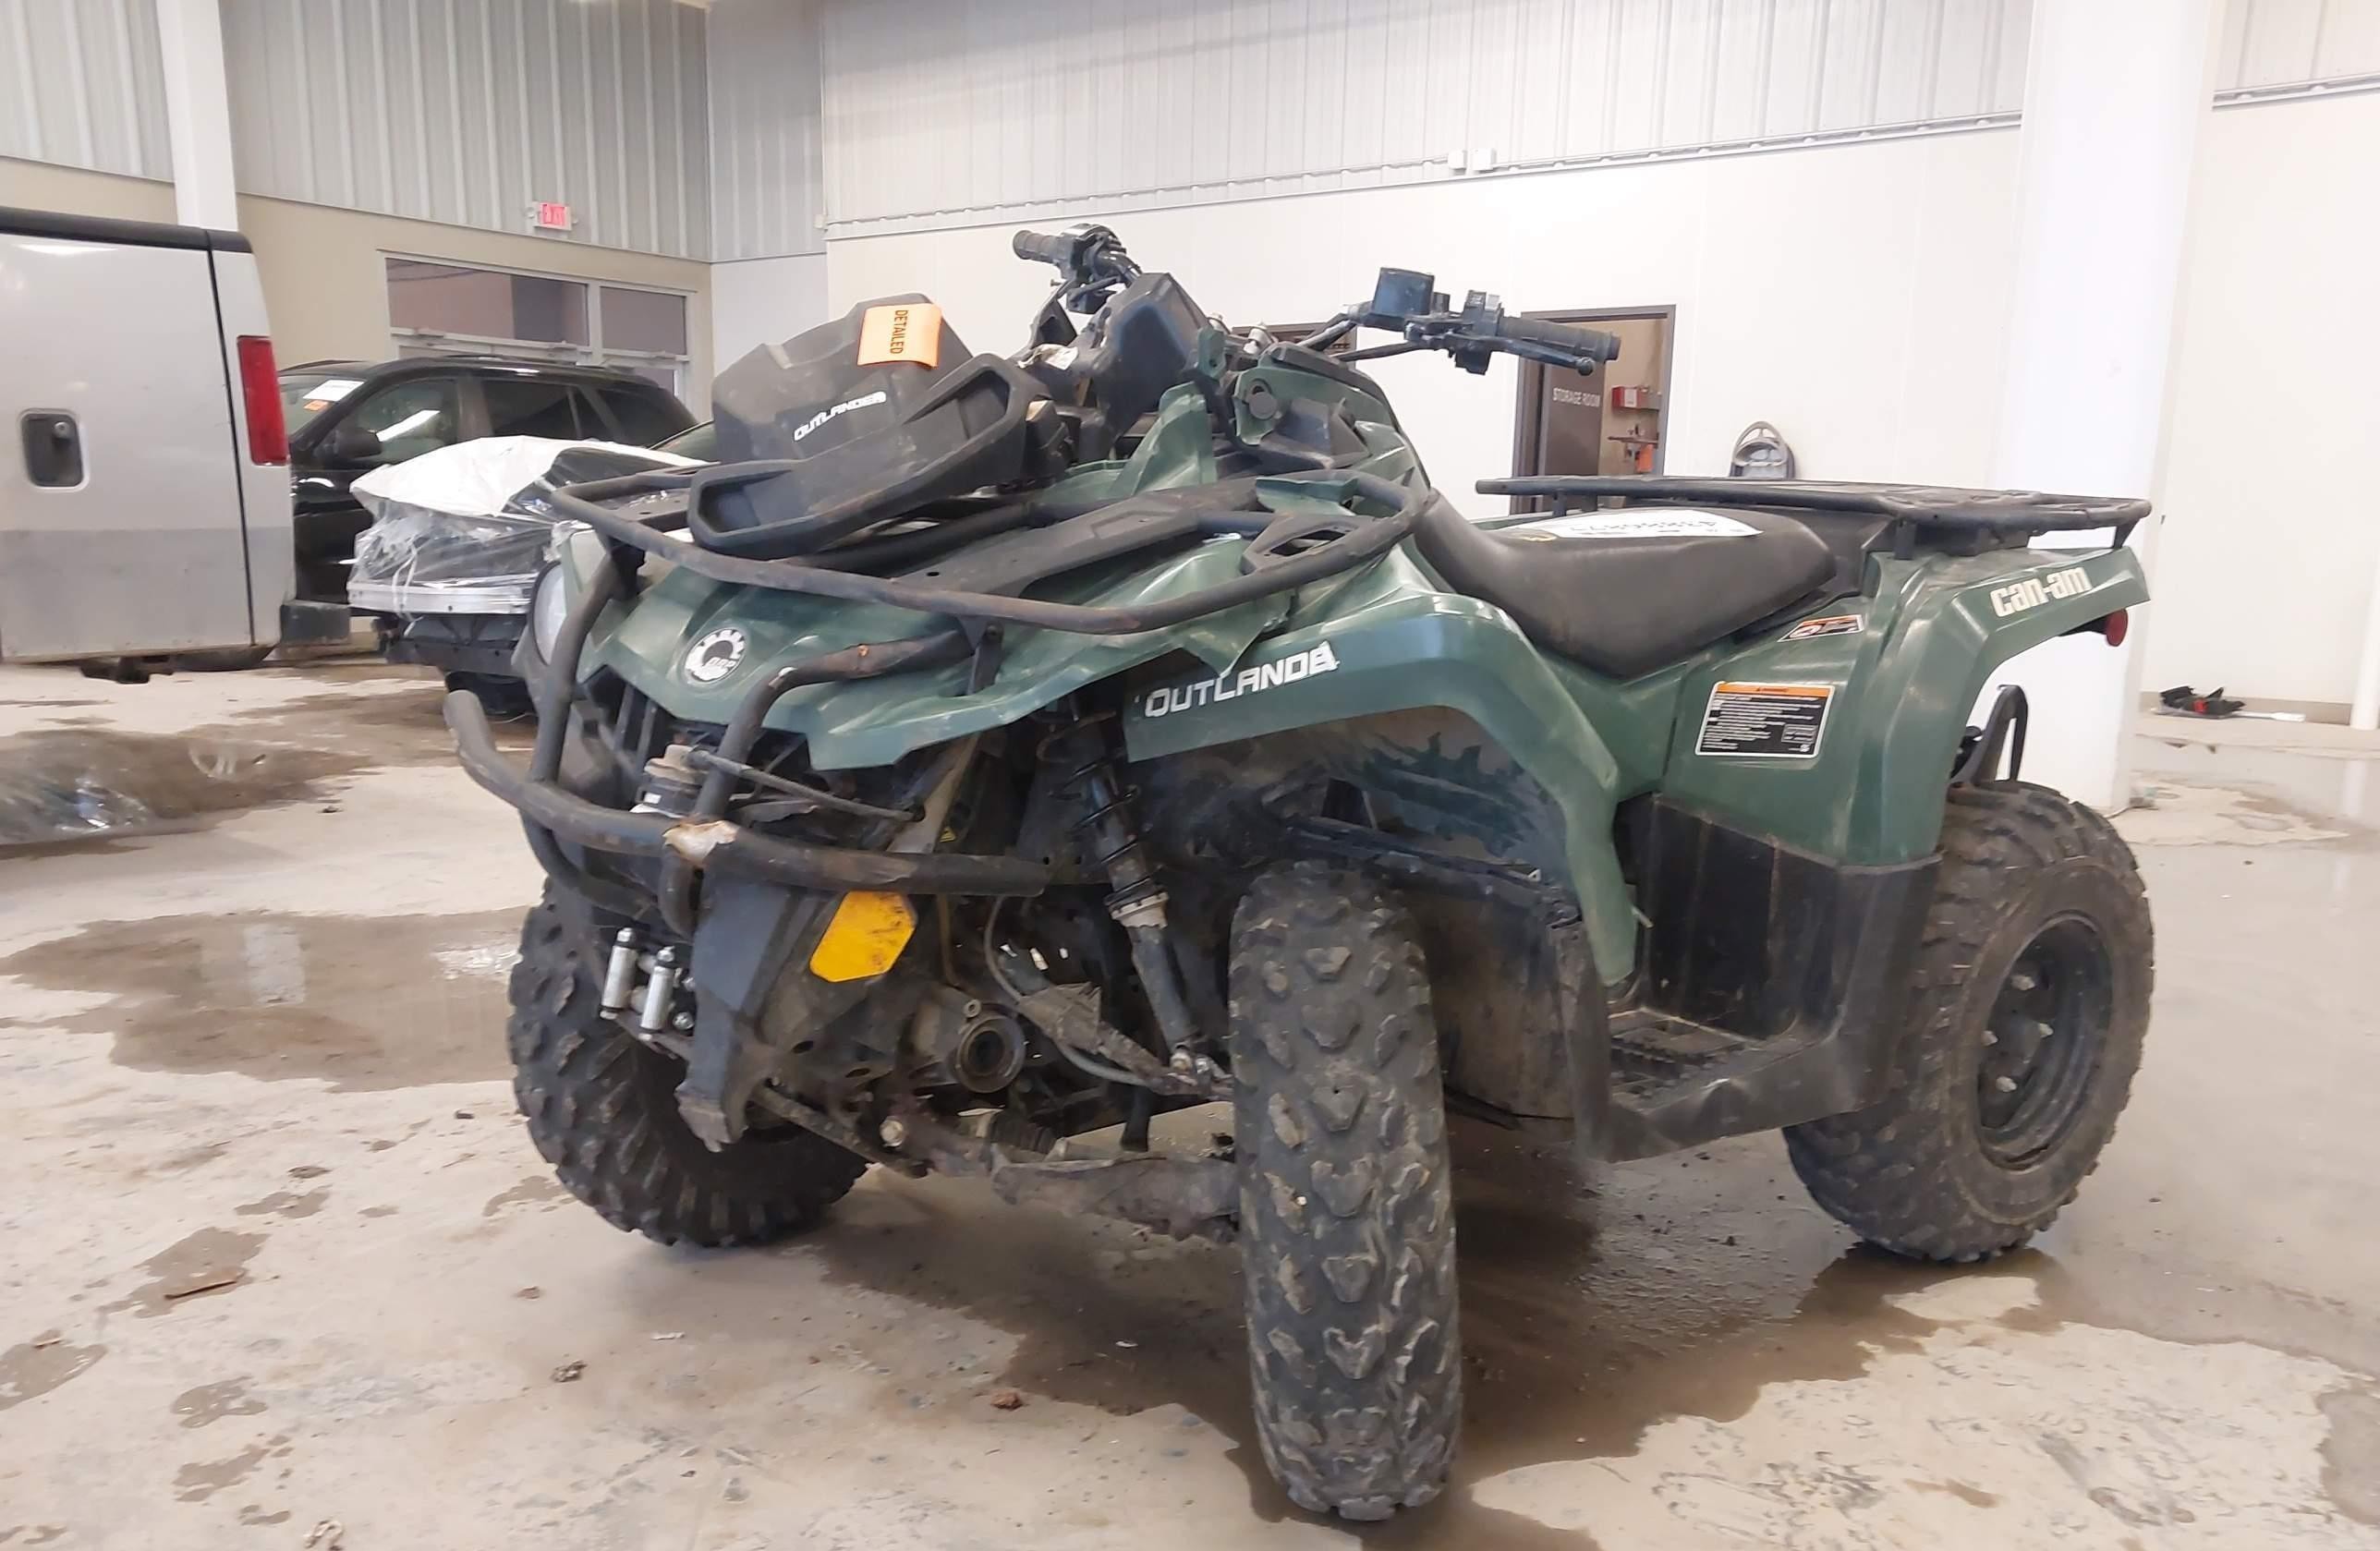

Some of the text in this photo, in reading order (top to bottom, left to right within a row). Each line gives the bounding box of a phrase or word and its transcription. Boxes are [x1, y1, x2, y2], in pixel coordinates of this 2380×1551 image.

[890, 309, 909, 355] DETAILED
[1553, 387, 1600, 407] STORAGE ROOM
[1145, 641, 1339, 717] OUTLANDE
